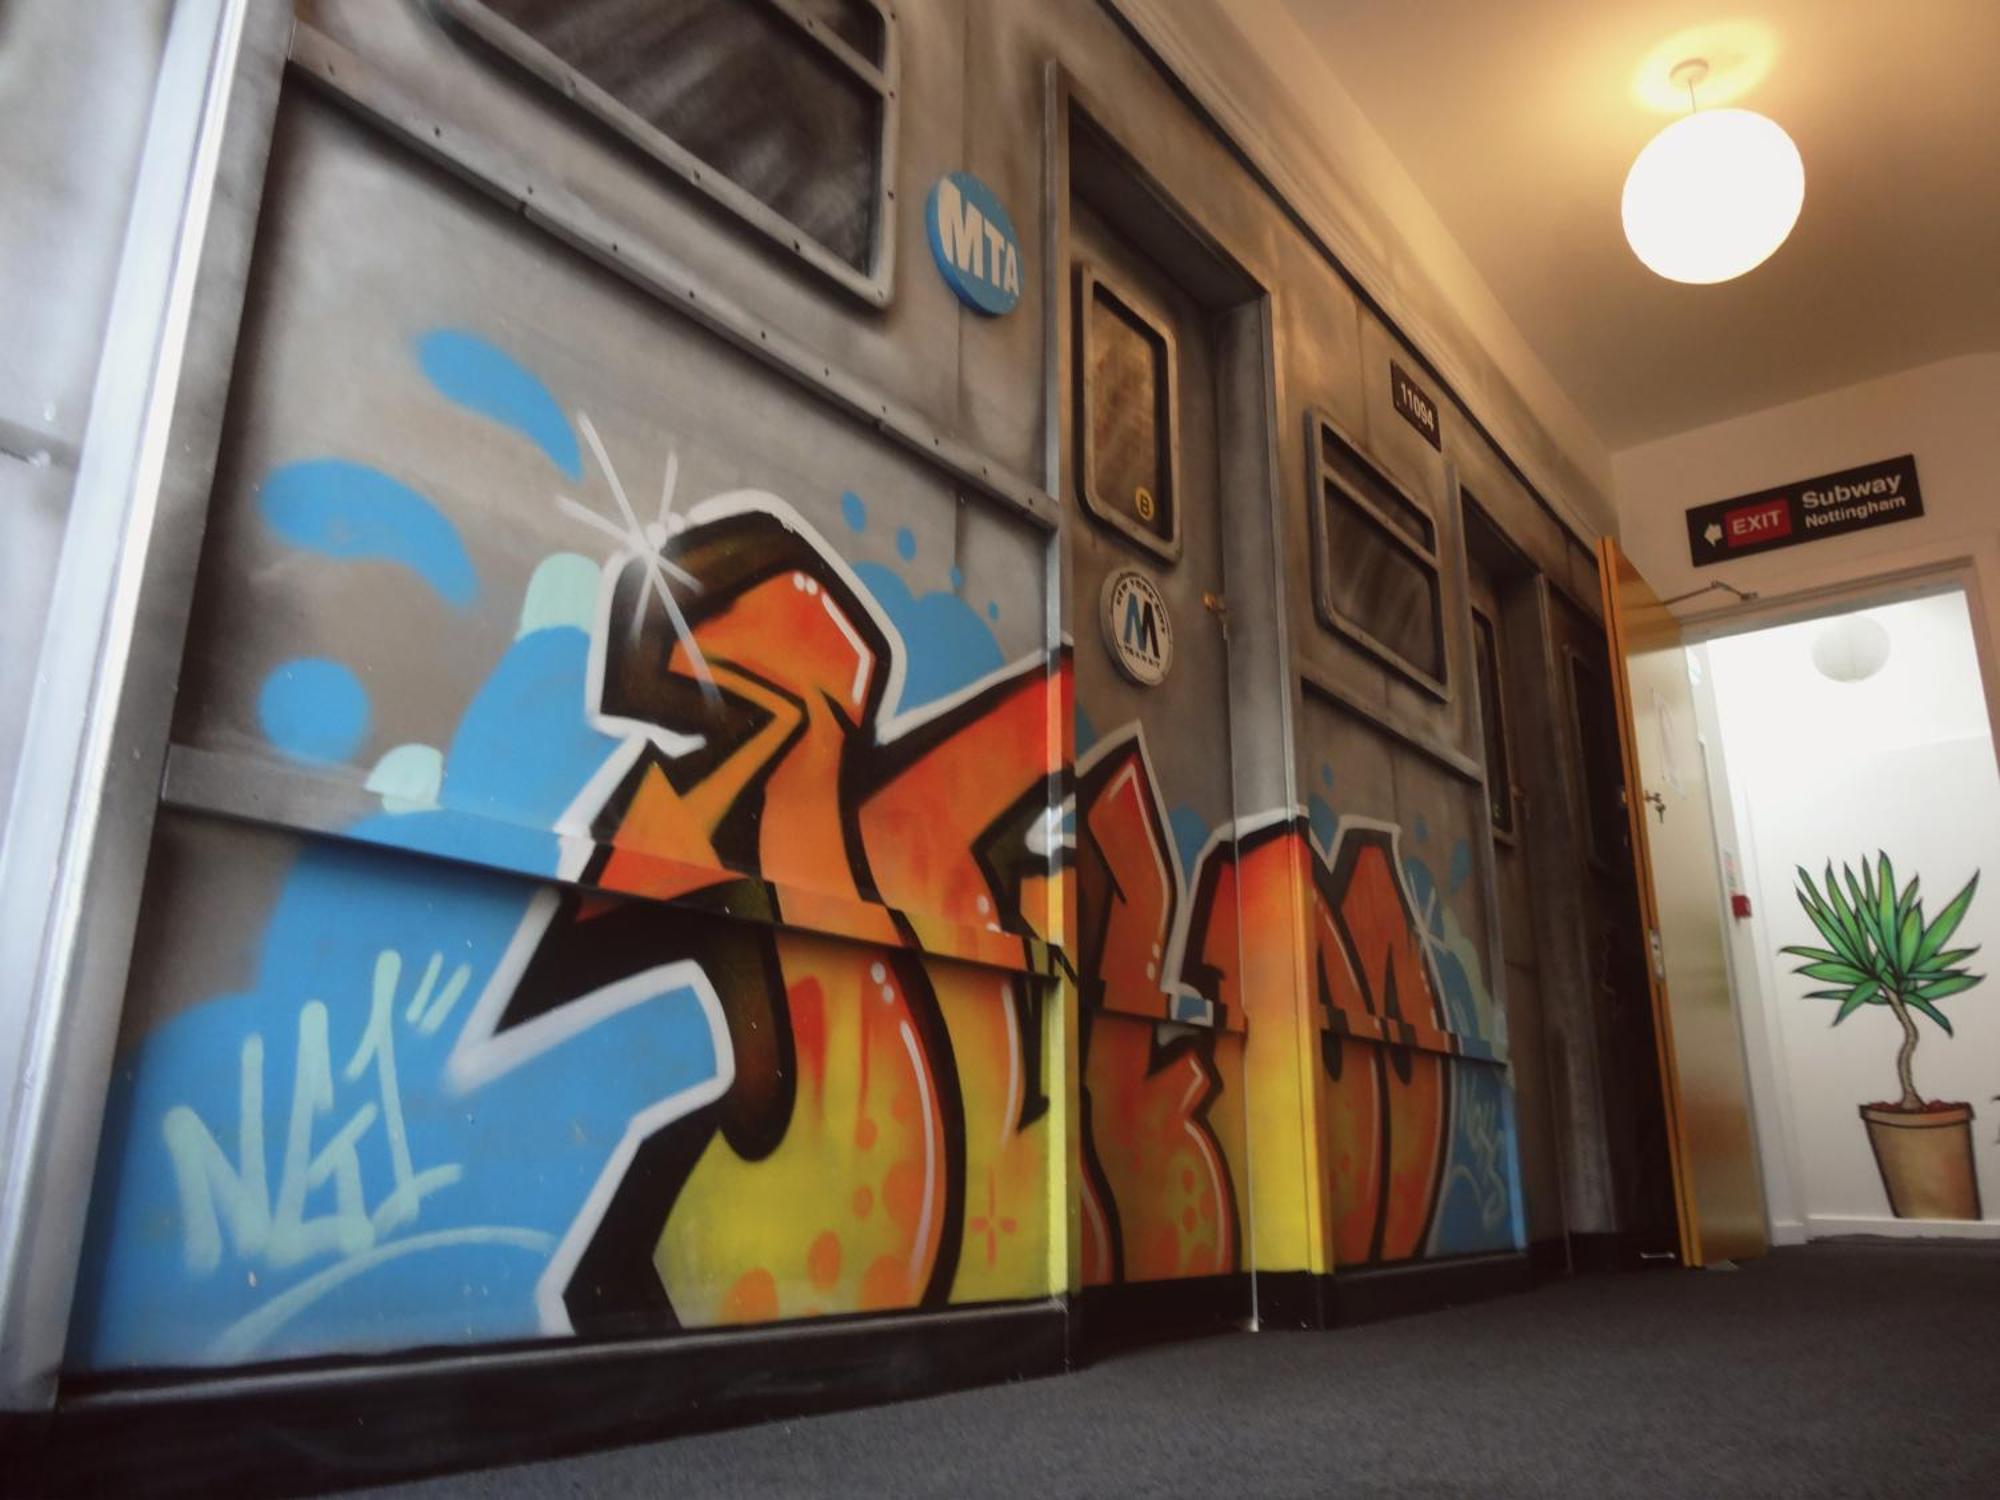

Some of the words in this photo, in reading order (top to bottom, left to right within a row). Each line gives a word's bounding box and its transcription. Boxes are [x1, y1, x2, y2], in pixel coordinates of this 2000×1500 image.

[938, 177, 1020, 297] MTA
[1802, 474, 1902, 508] Subway
[1732, 510, 1782, 535] EXIT
[1805, 496, 1906, 528] Nottingham
